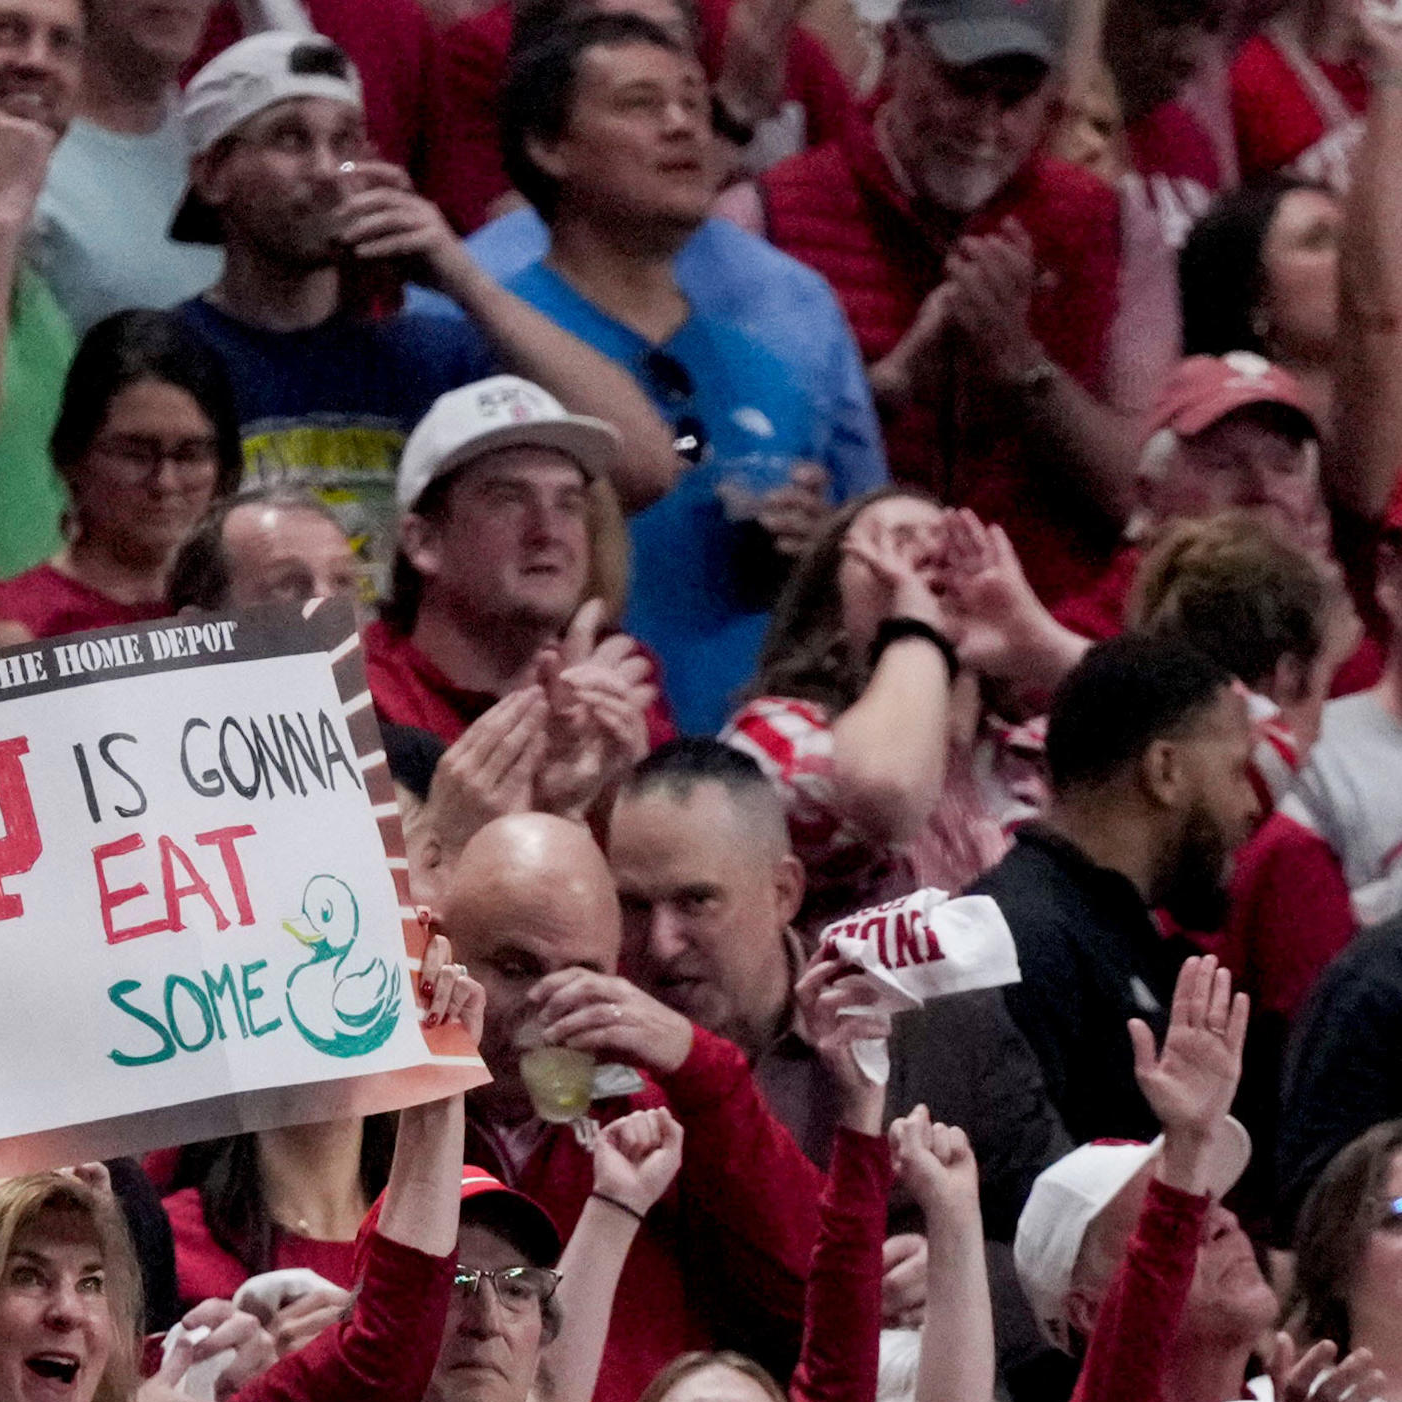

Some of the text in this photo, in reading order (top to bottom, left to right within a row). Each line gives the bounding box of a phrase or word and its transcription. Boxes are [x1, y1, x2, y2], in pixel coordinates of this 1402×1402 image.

[53, 633, 145, 678] HOME
[146, 620, 237, 662] DEPOT
[72, 731, 148, 823] IS
[180, 708, 363, 801] GONNA
[91, 823, 257, 946] EAT
[106, 958, 283, 1068] SOME
